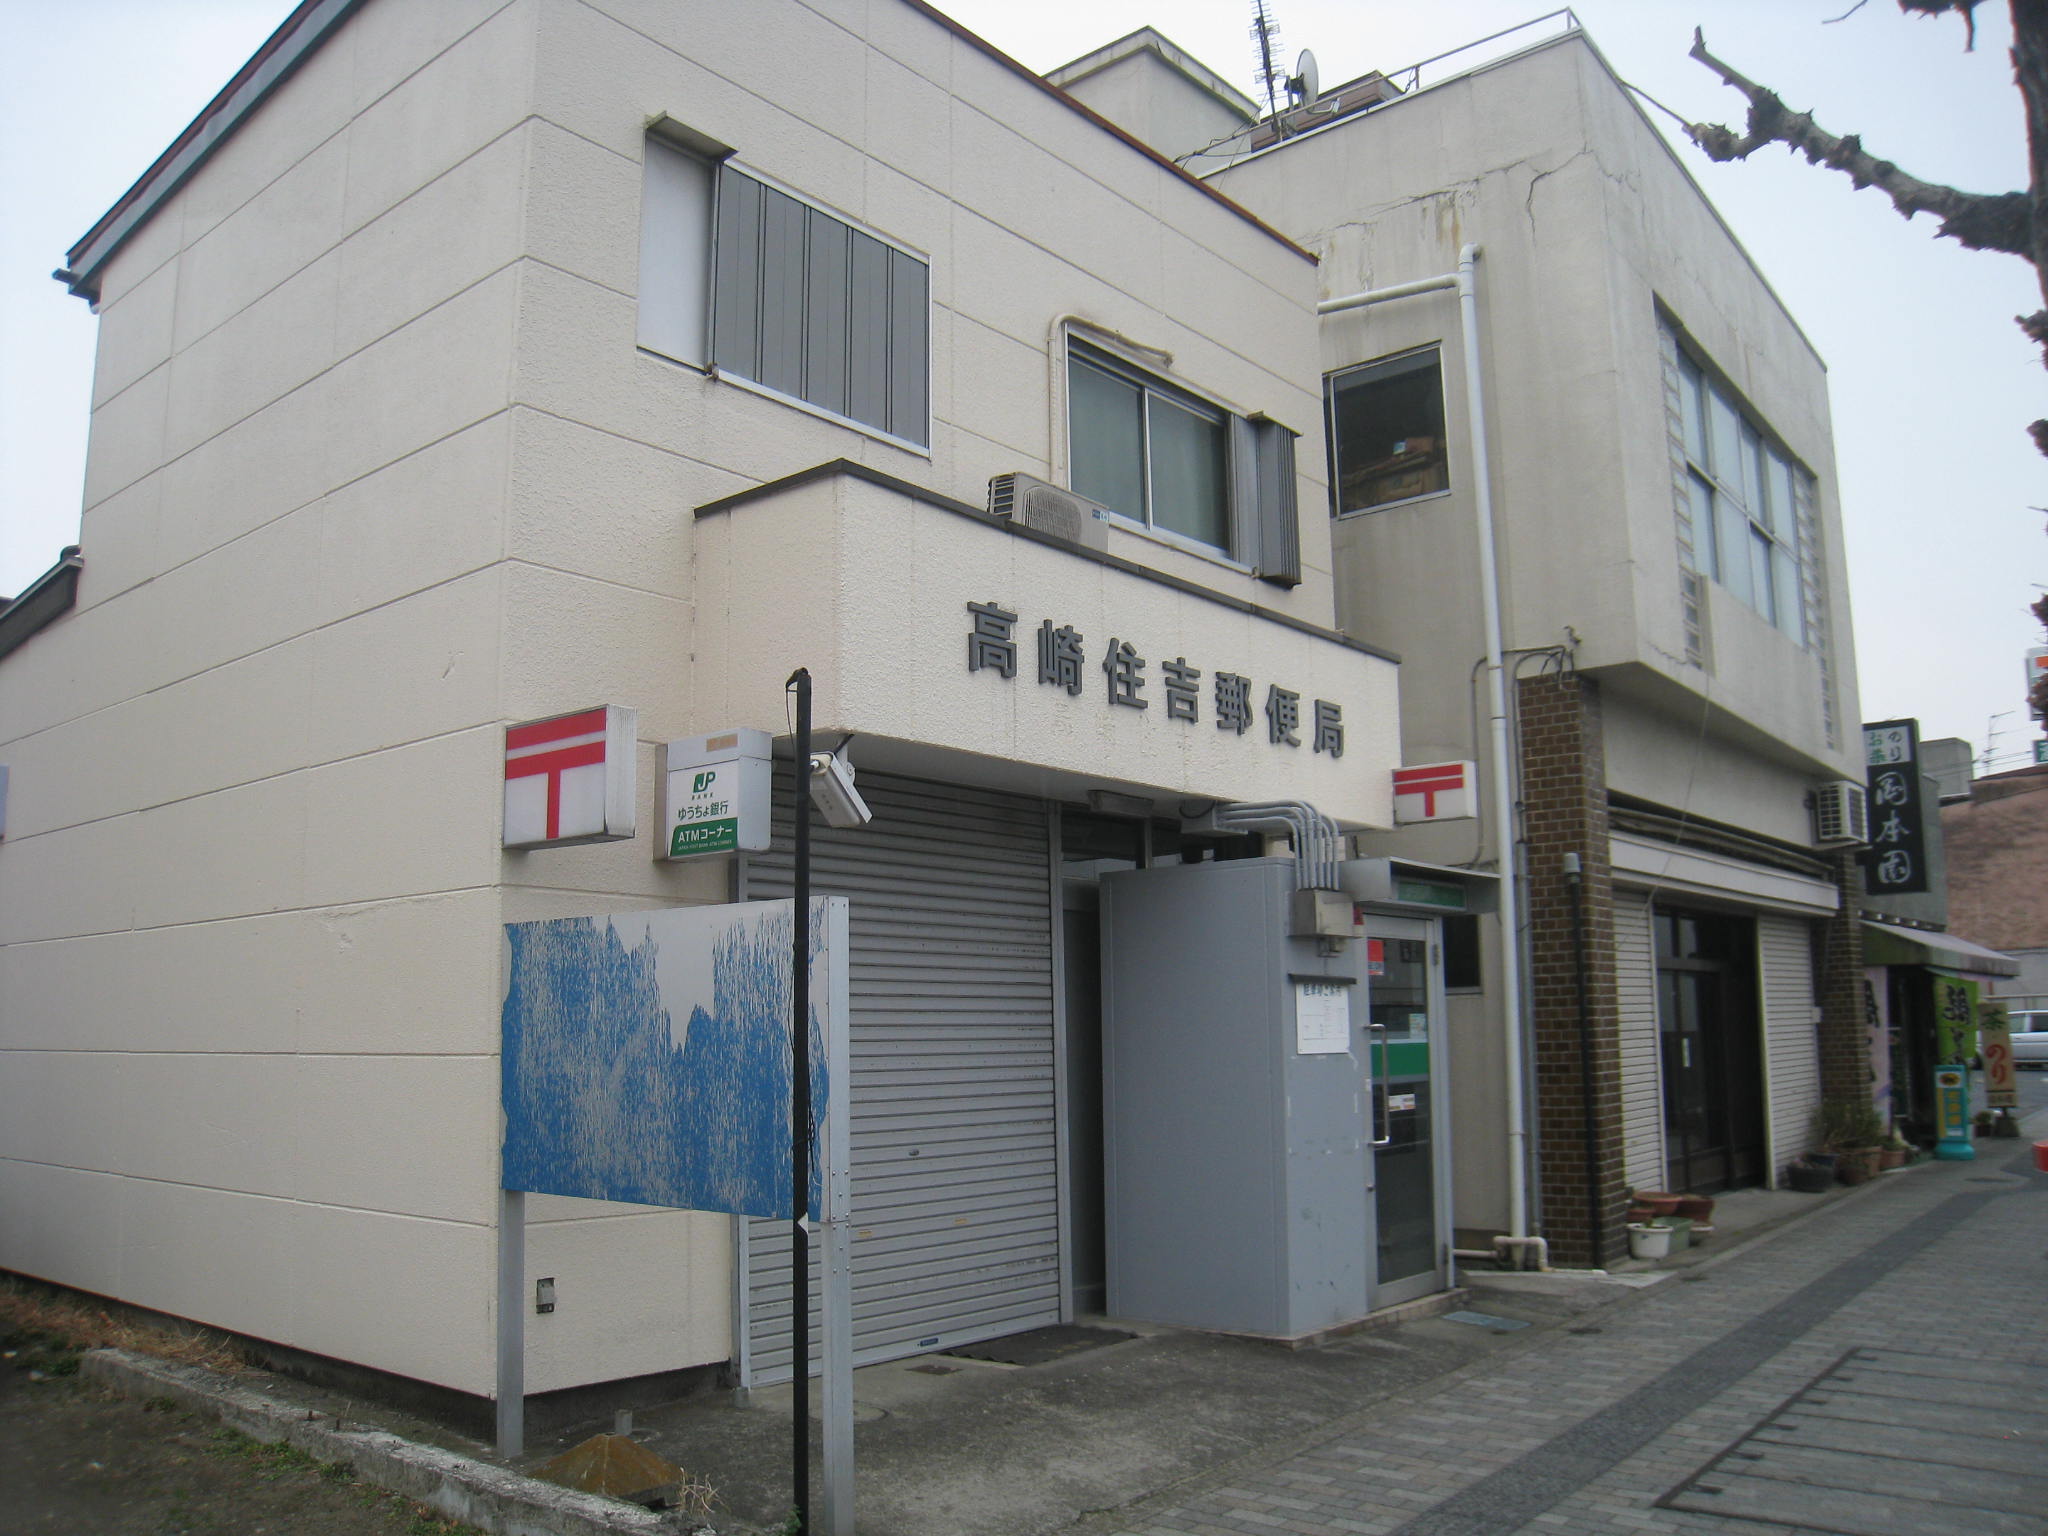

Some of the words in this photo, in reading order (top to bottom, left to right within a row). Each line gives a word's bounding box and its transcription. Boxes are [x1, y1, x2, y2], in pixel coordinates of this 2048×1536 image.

[967, 601, 1345, 758] 高崎住吉郵便局
[678, 800, 729, 820] ゆうちょ銀行
